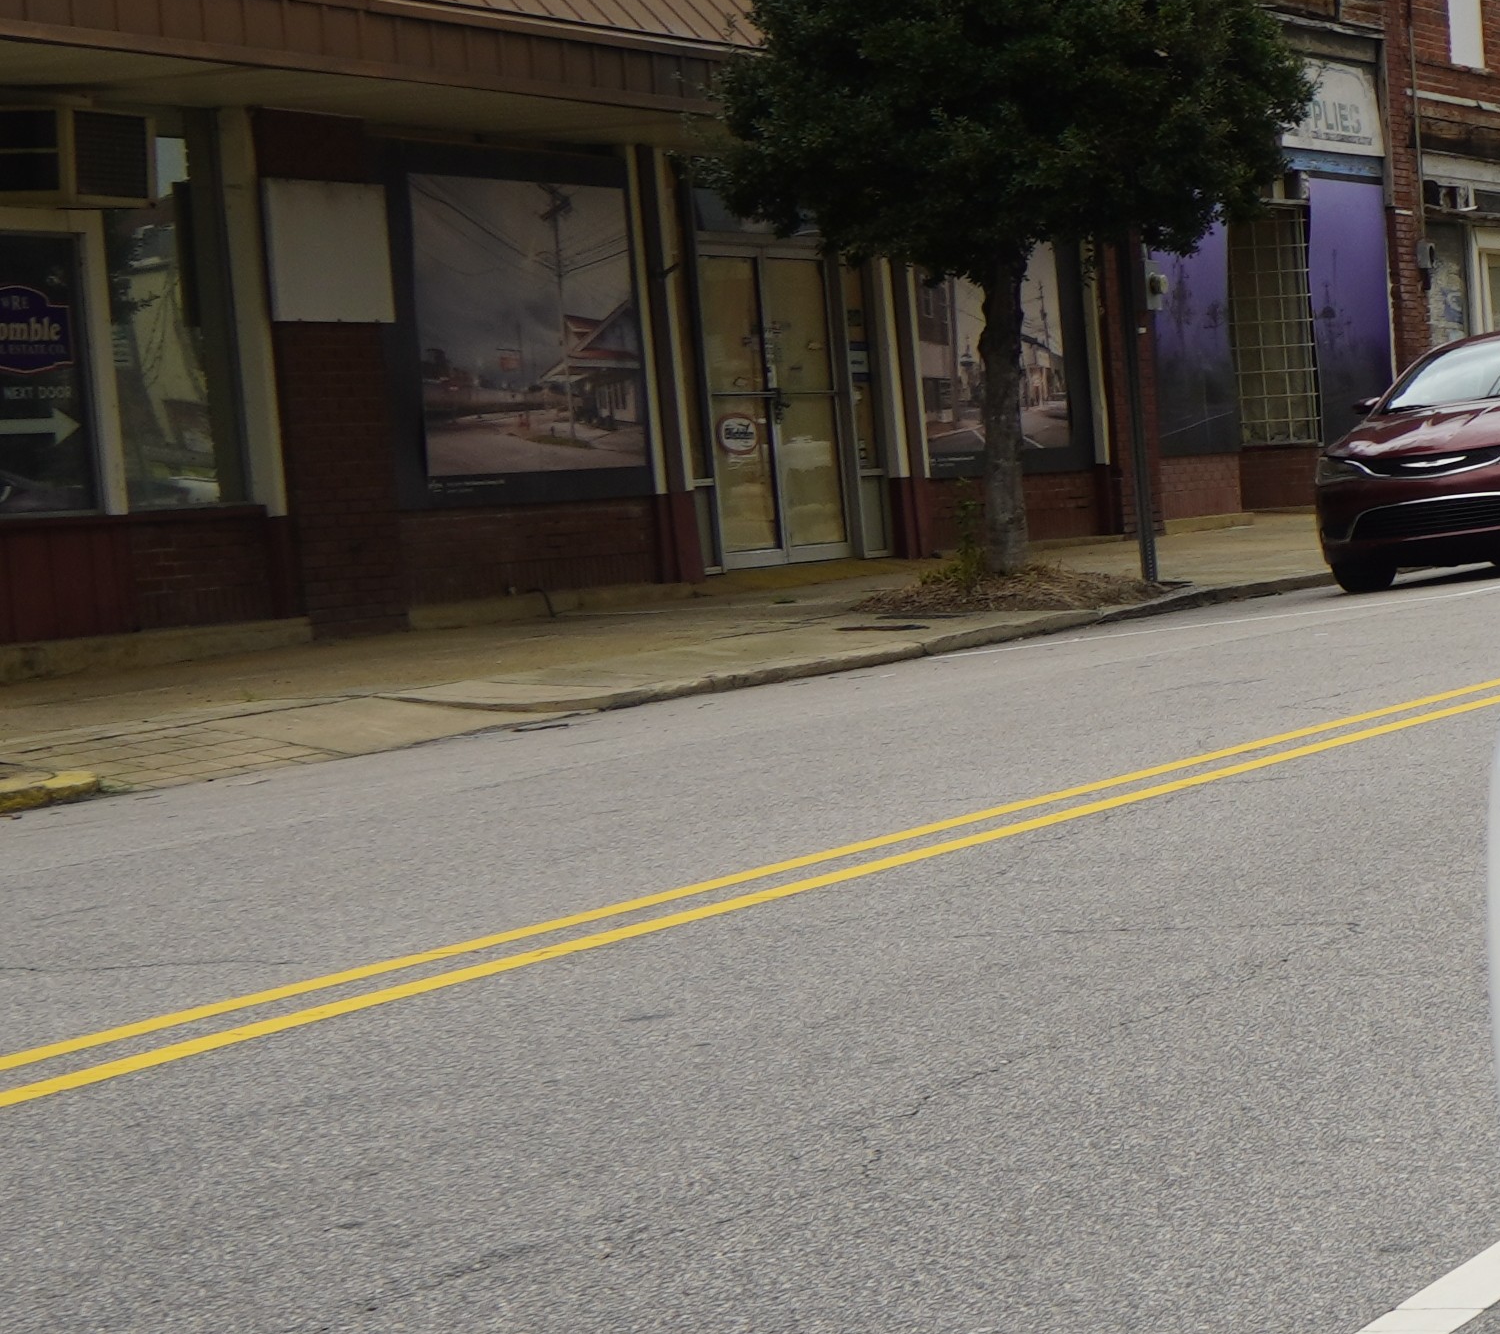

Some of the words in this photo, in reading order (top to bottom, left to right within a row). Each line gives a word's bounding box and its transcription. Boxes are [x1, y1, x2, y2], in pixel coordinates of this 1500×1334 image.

[1308, 100, 1362, 134] PLIES
[3, 386, 33, 399] NEXT
[38, 386, 72, 399] DOOR
